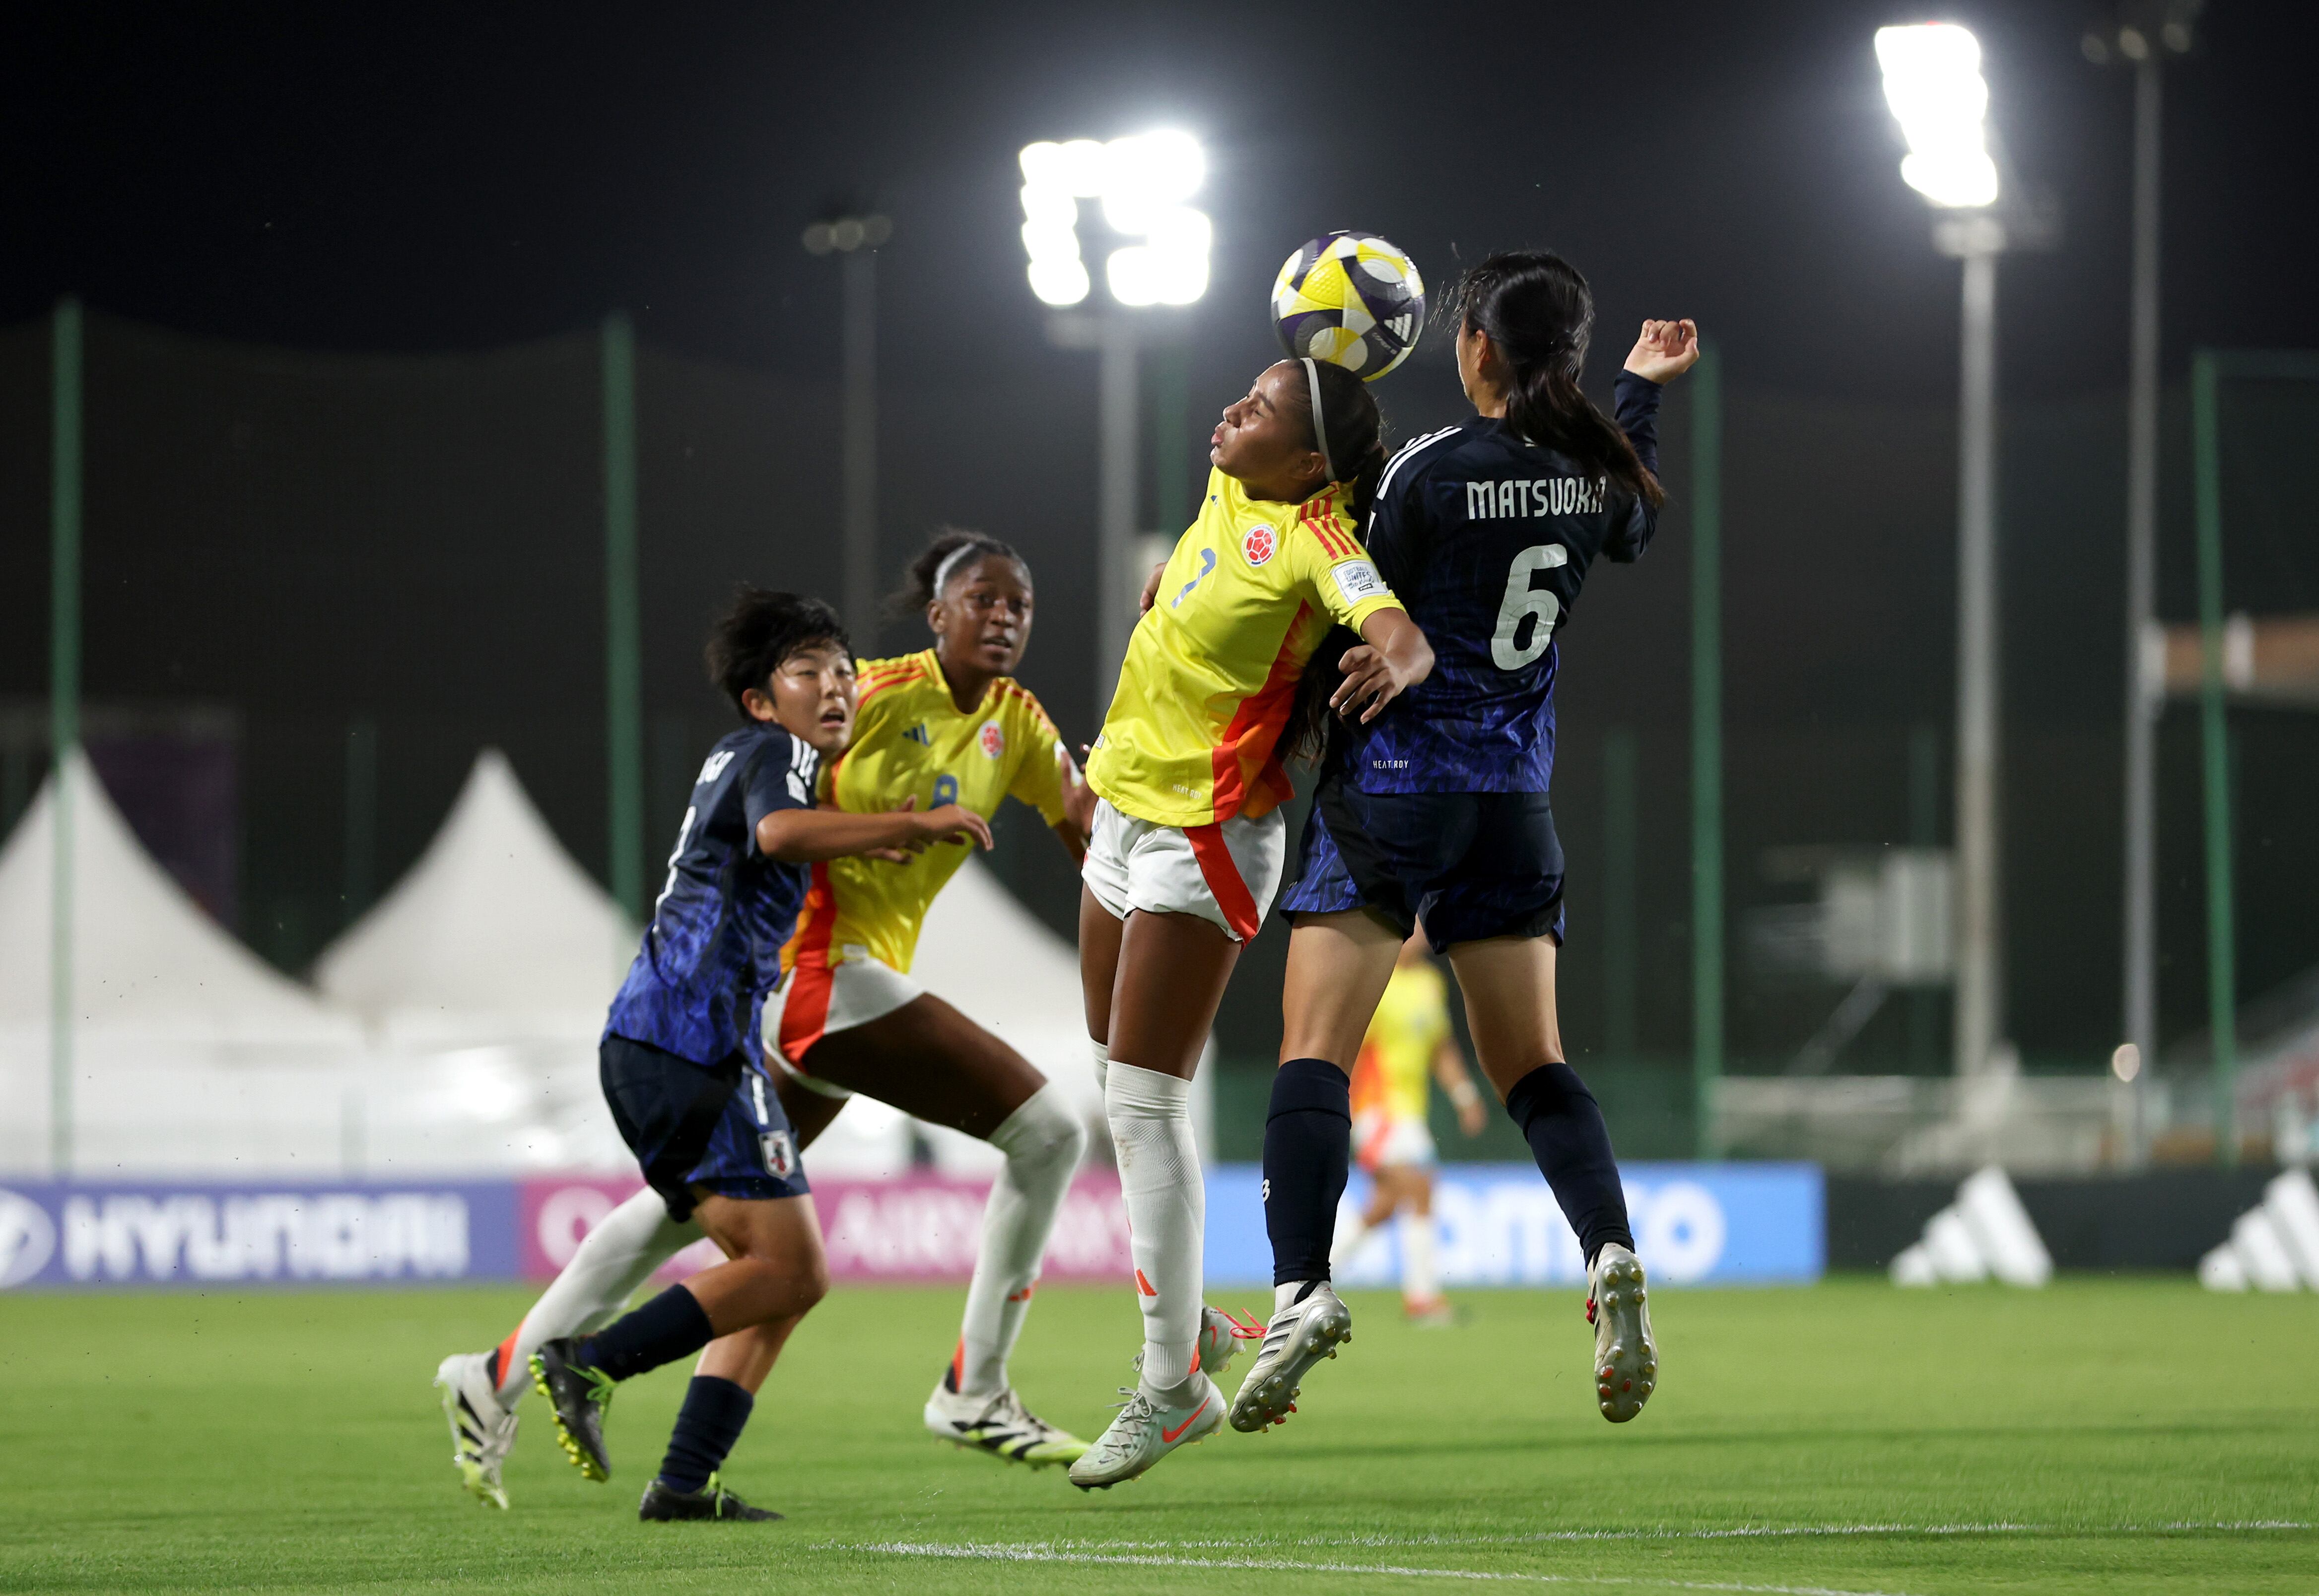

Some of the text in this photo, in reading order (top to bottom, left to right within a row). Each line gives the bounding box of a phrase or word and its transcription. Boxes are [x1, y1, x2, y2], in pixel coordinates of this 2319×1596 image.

[1171, 547, 1216, 609] 7
[1491, 543, 1568, 670] 6
[1373, 760, 1409, 769] HEAT.RDY
[65, 1196, 466, 1278] HYUNDAI
